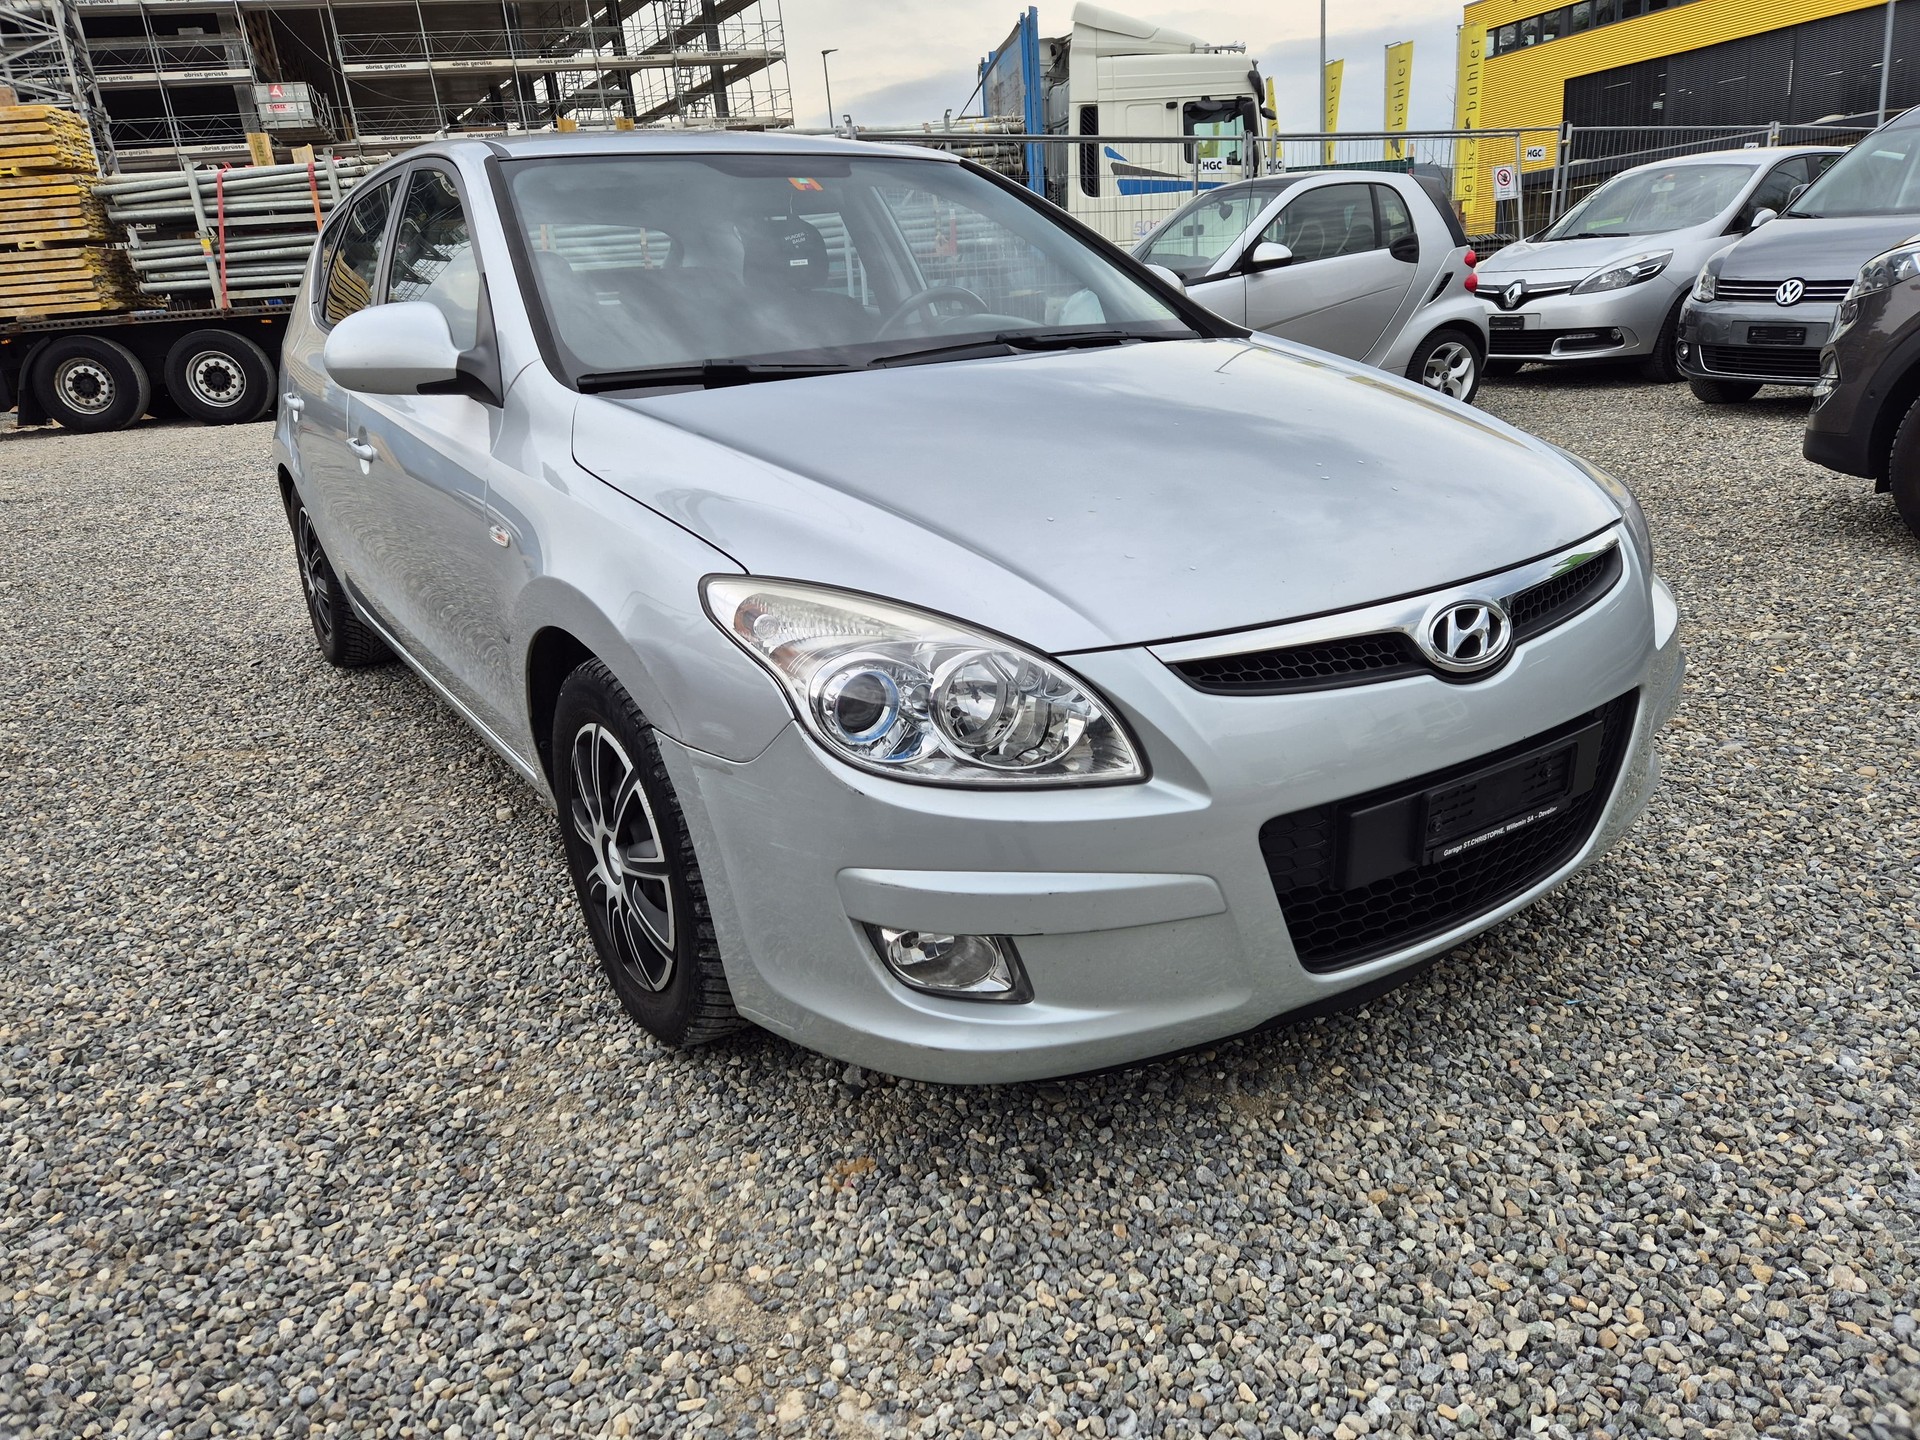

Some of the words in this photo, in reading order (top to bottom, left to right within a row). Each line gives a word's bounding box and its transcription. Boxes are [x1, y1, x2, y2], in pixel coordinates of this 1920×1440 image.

[1392, 58, 1406, 127] bühler
[1527, 148, 1543, 158] HGC
[1202, 161, 1223, 171] HGC
[1266, 160, 1283, 170] HC
[1443, 844, 1463, 857] Garage
[1527, 814, 1534, 823] SA
